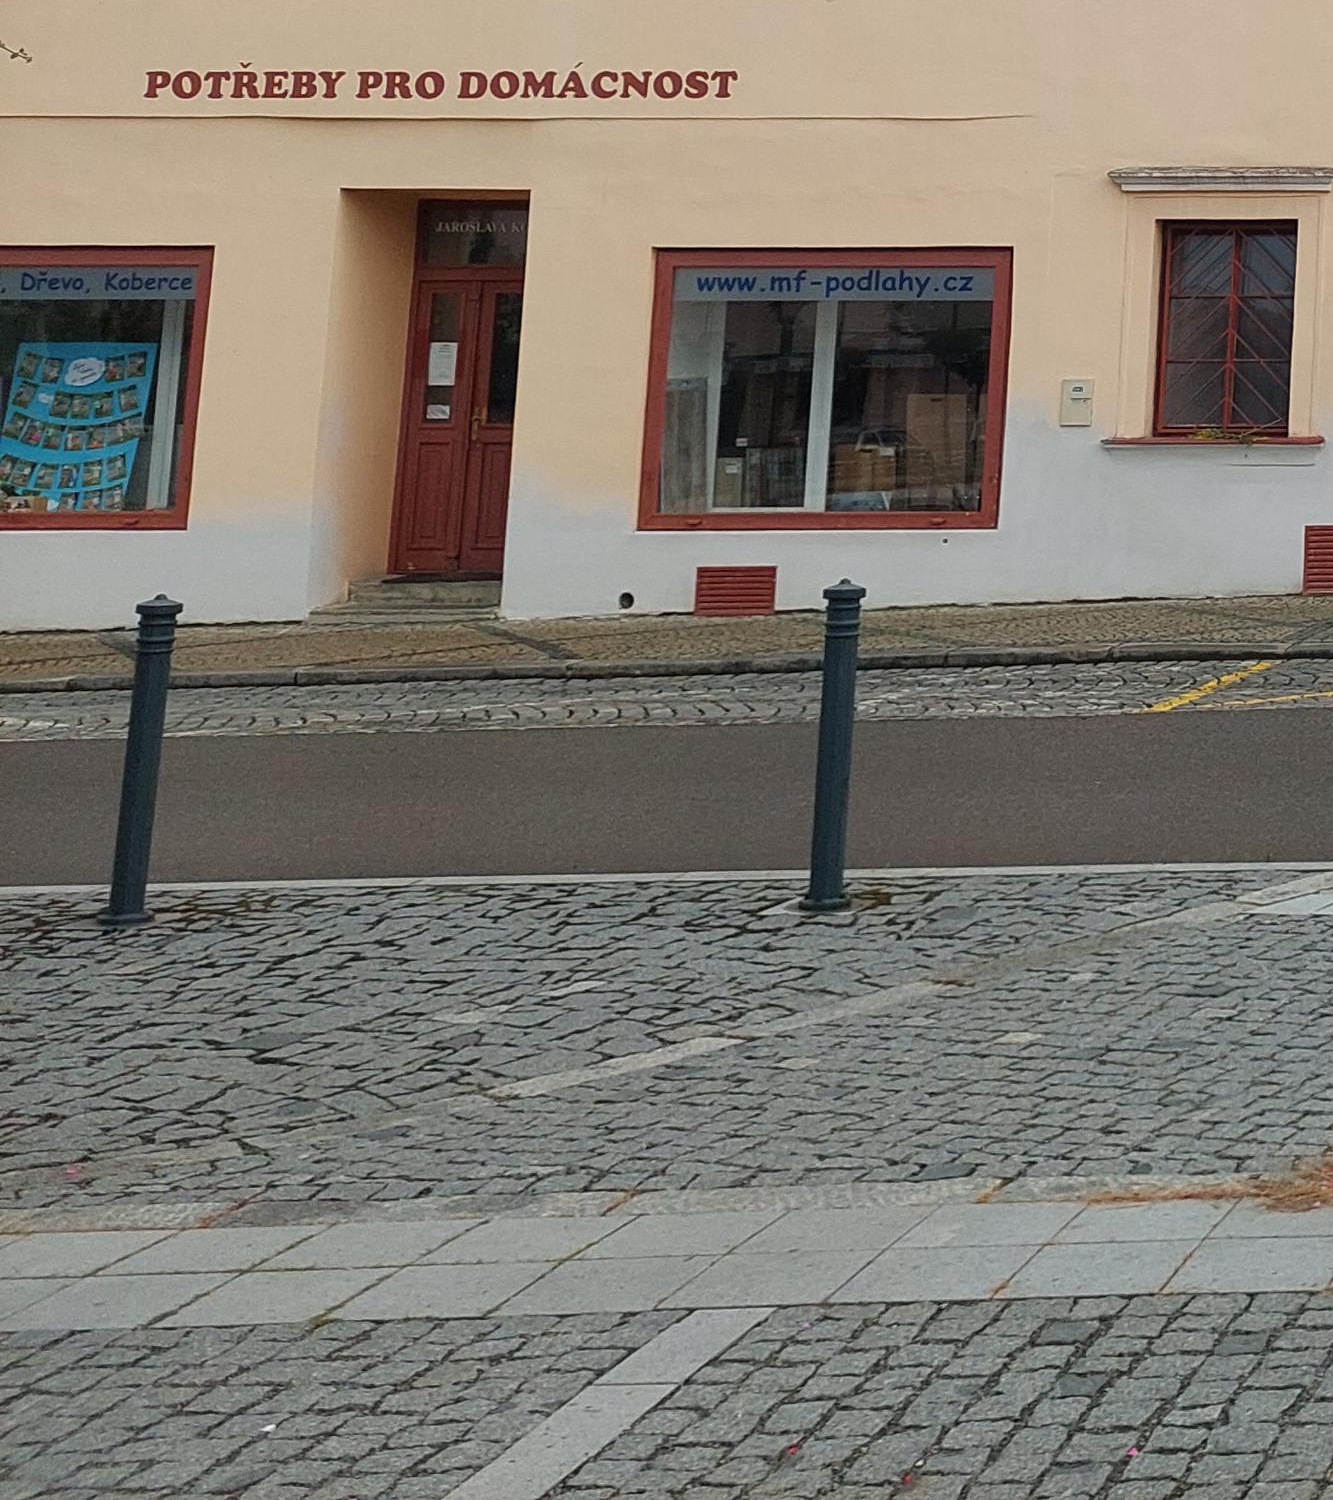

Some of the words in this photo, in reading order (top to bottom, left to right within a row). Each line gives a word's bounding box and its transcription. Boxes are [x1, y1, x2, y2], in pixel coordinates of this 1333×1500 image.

[143, 62, 346, 100] POTŘEBY
[354, 71, 446, 100] PRO
[456, 61, 739, 100] DOMÁCNOST
[20, 271, 91, 294] Dřevo,
[104, 272, 193, 292] Koberce
[696, 269, 974, 298] www.mf-podlahy.cz
